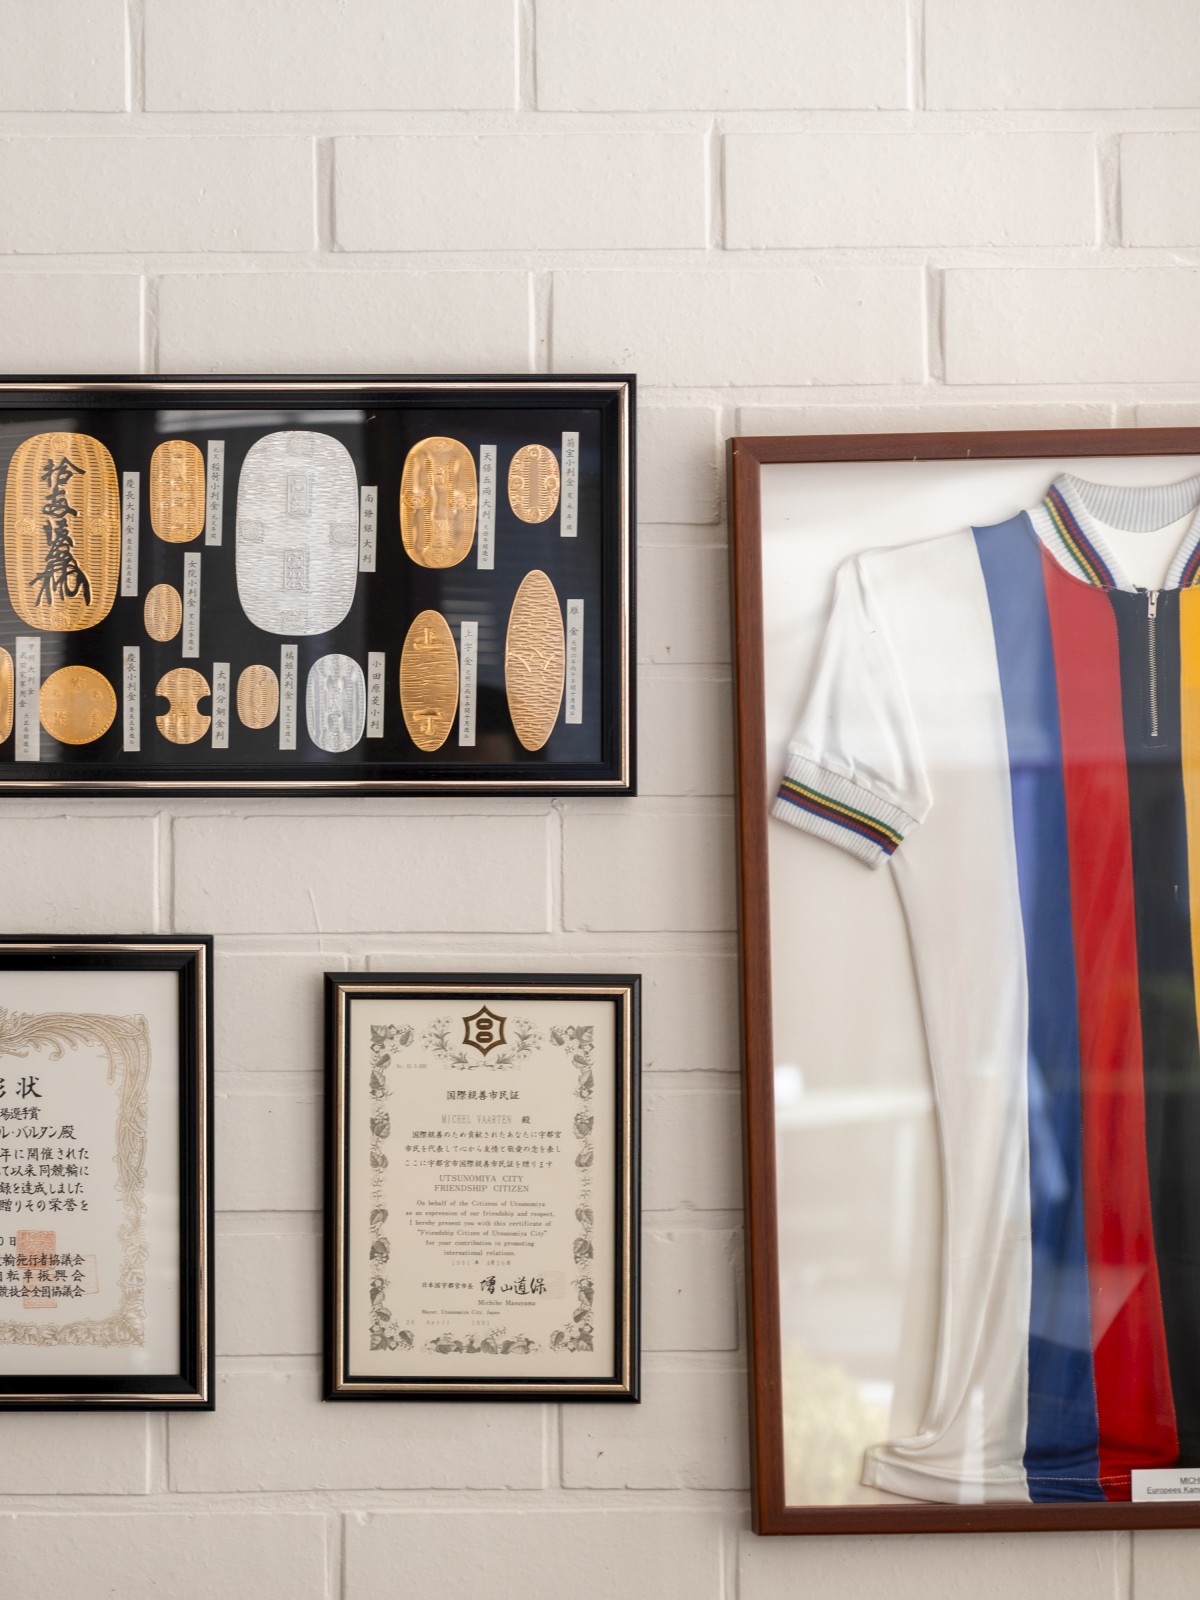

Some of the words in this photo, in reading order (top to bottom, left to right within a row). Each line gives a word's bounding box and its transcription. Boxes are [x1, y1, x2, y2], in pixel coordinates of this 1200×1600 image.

[125, 479, 136, 535] 慶長大判金
[464, 629, 474, 666] 上字金
[126, 653, 137, 701] 慶長小判金
[446, 1090, 520, 1101] 国際親善市民証
[441, 1114, 472, 1124] MICHEL
[477, 1115, 512, 1124] VAARTEN
[439, 1174, 497, 1182] UTSUNOMIYA
[502, 1175, 523, 1183] CITY
[434, 1184, 488, 1192] FRIENDSHIP
[493, 1185, 529, 1193] CITIZEN
[510, 1200, 545, 1208] Utsunomiya
[483, 1210, 515, 1218] friendship
[421, 1282, 474, 1290] 日本国宇都宮市長
[1147, 1487, 1181, 1495] Europees
